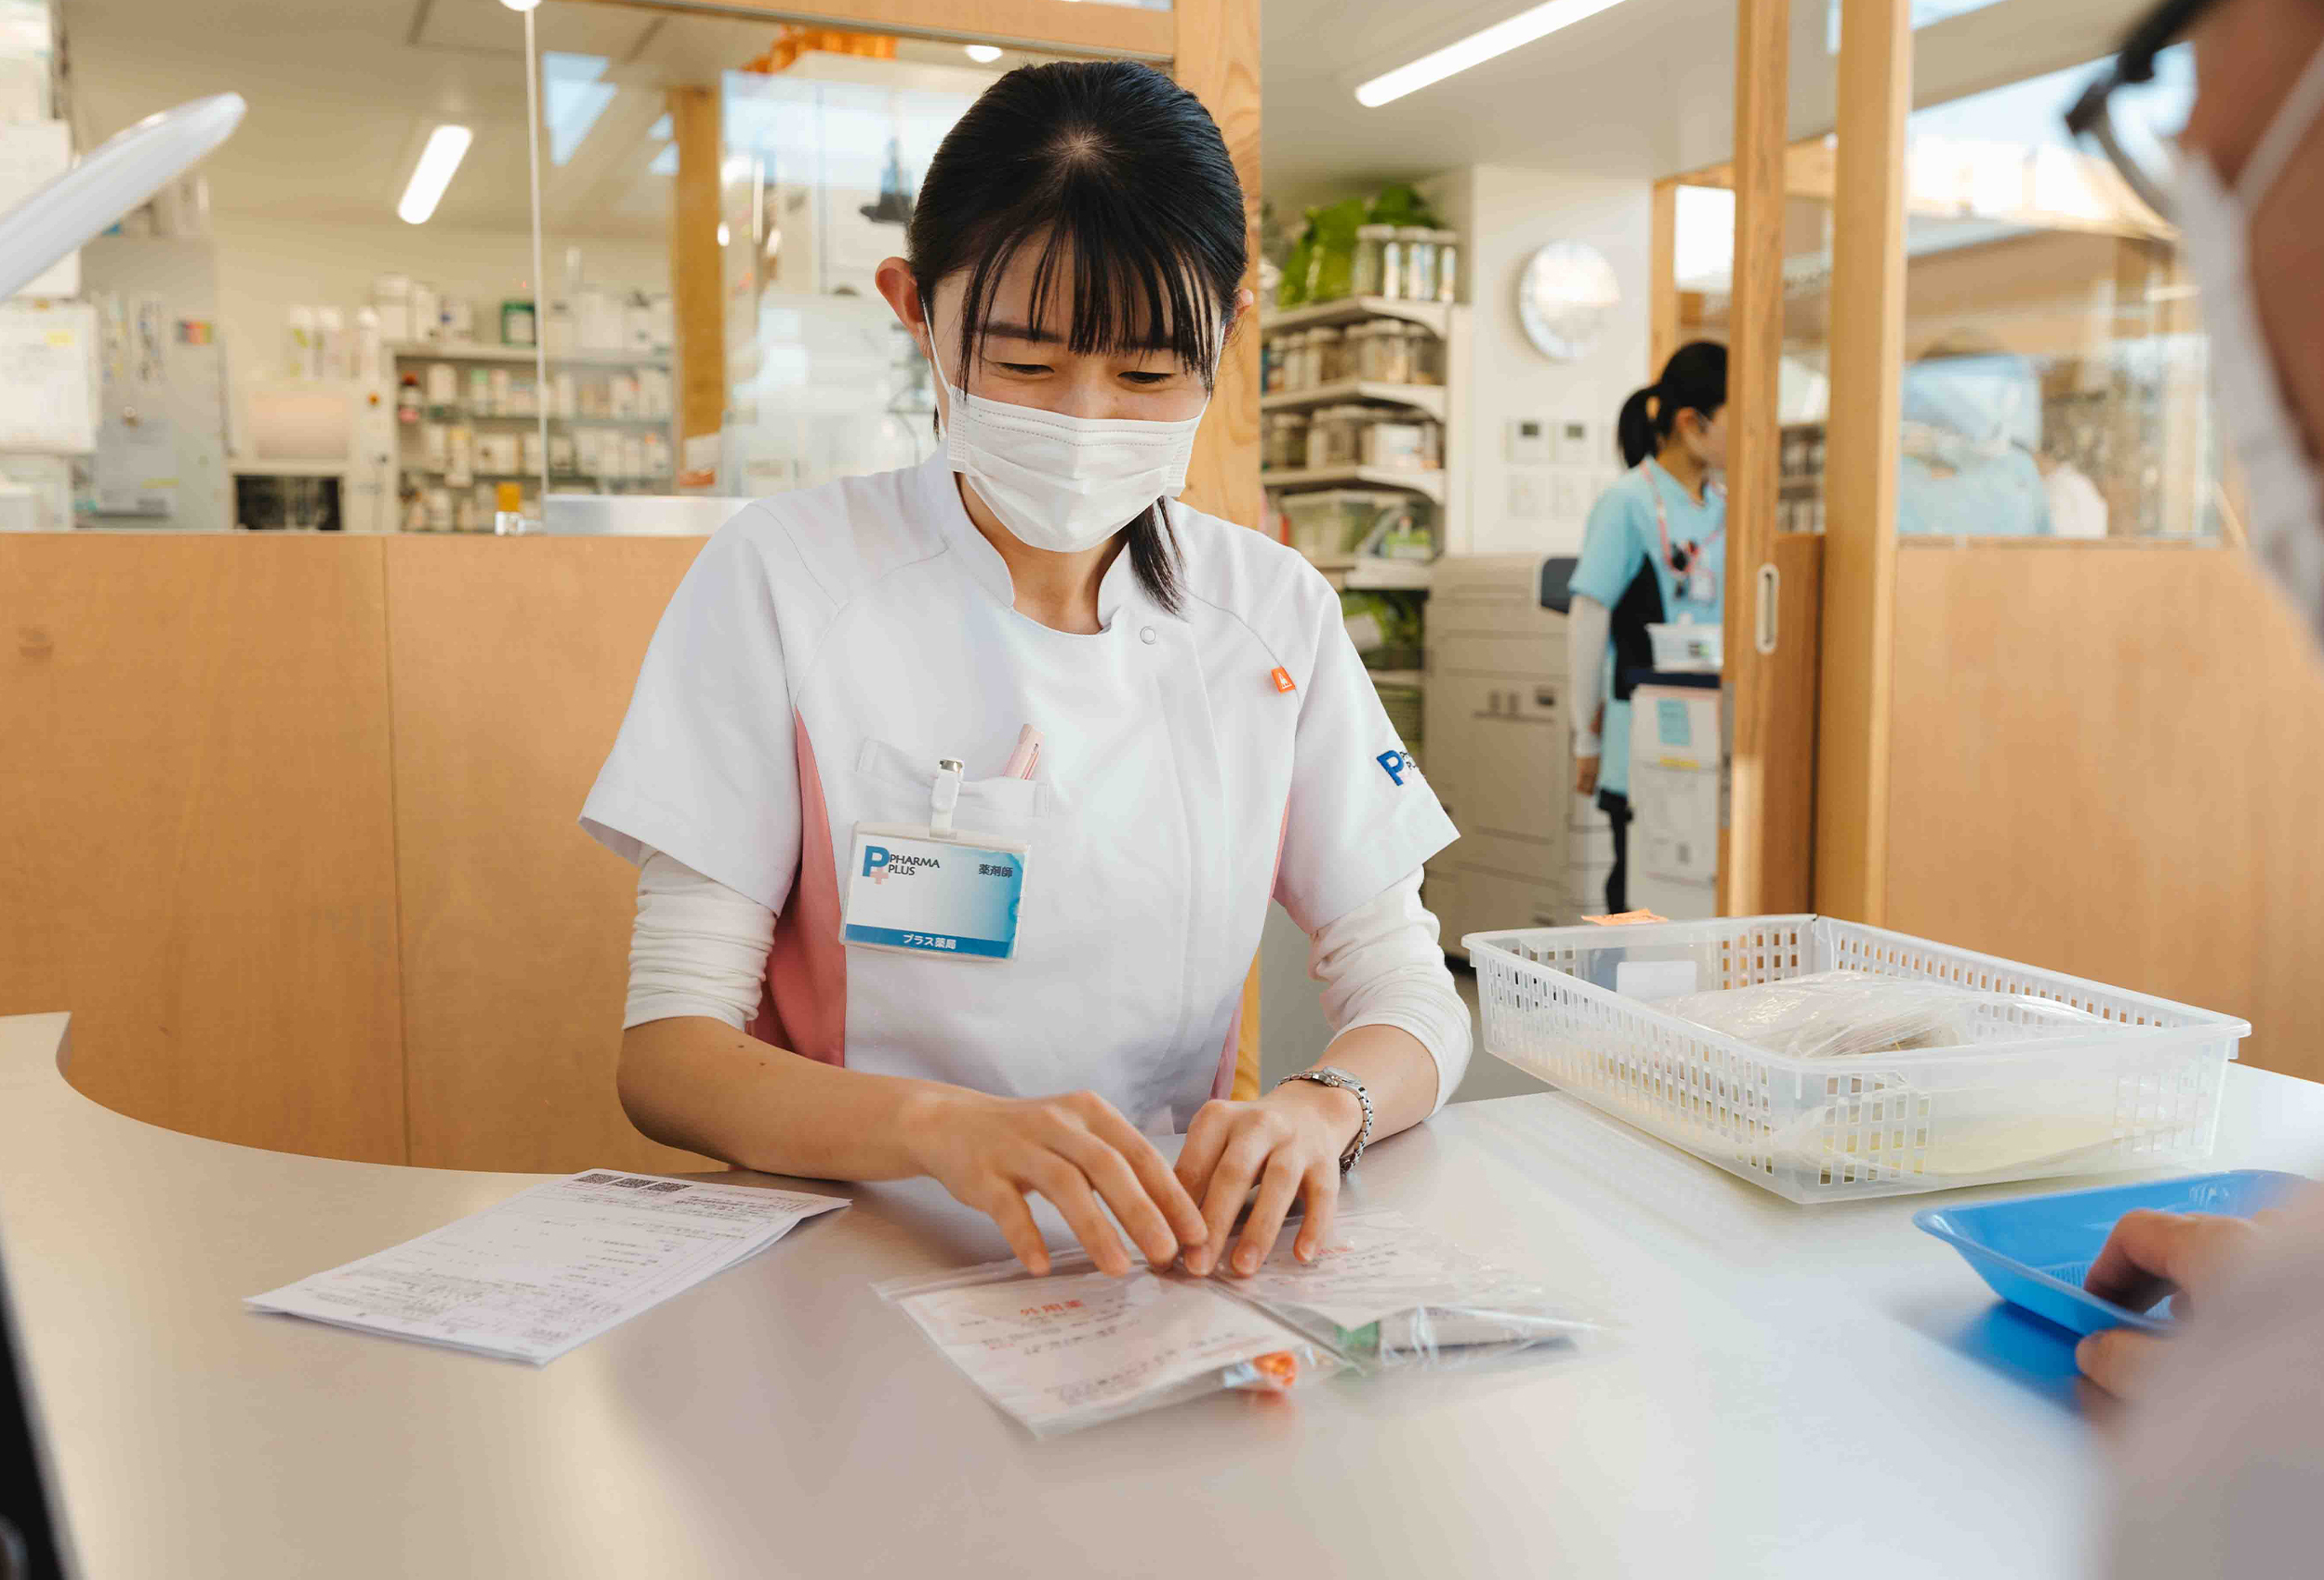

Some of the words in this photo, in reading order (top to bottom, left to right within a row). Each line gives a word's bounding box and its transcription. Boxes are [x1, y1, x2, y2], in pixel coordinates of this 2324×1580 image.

[890, 854, 940, 868] PHARMA
[888, 864, 916, 876] PLUS
[979, 863, 1013, 878] 薬剤師
